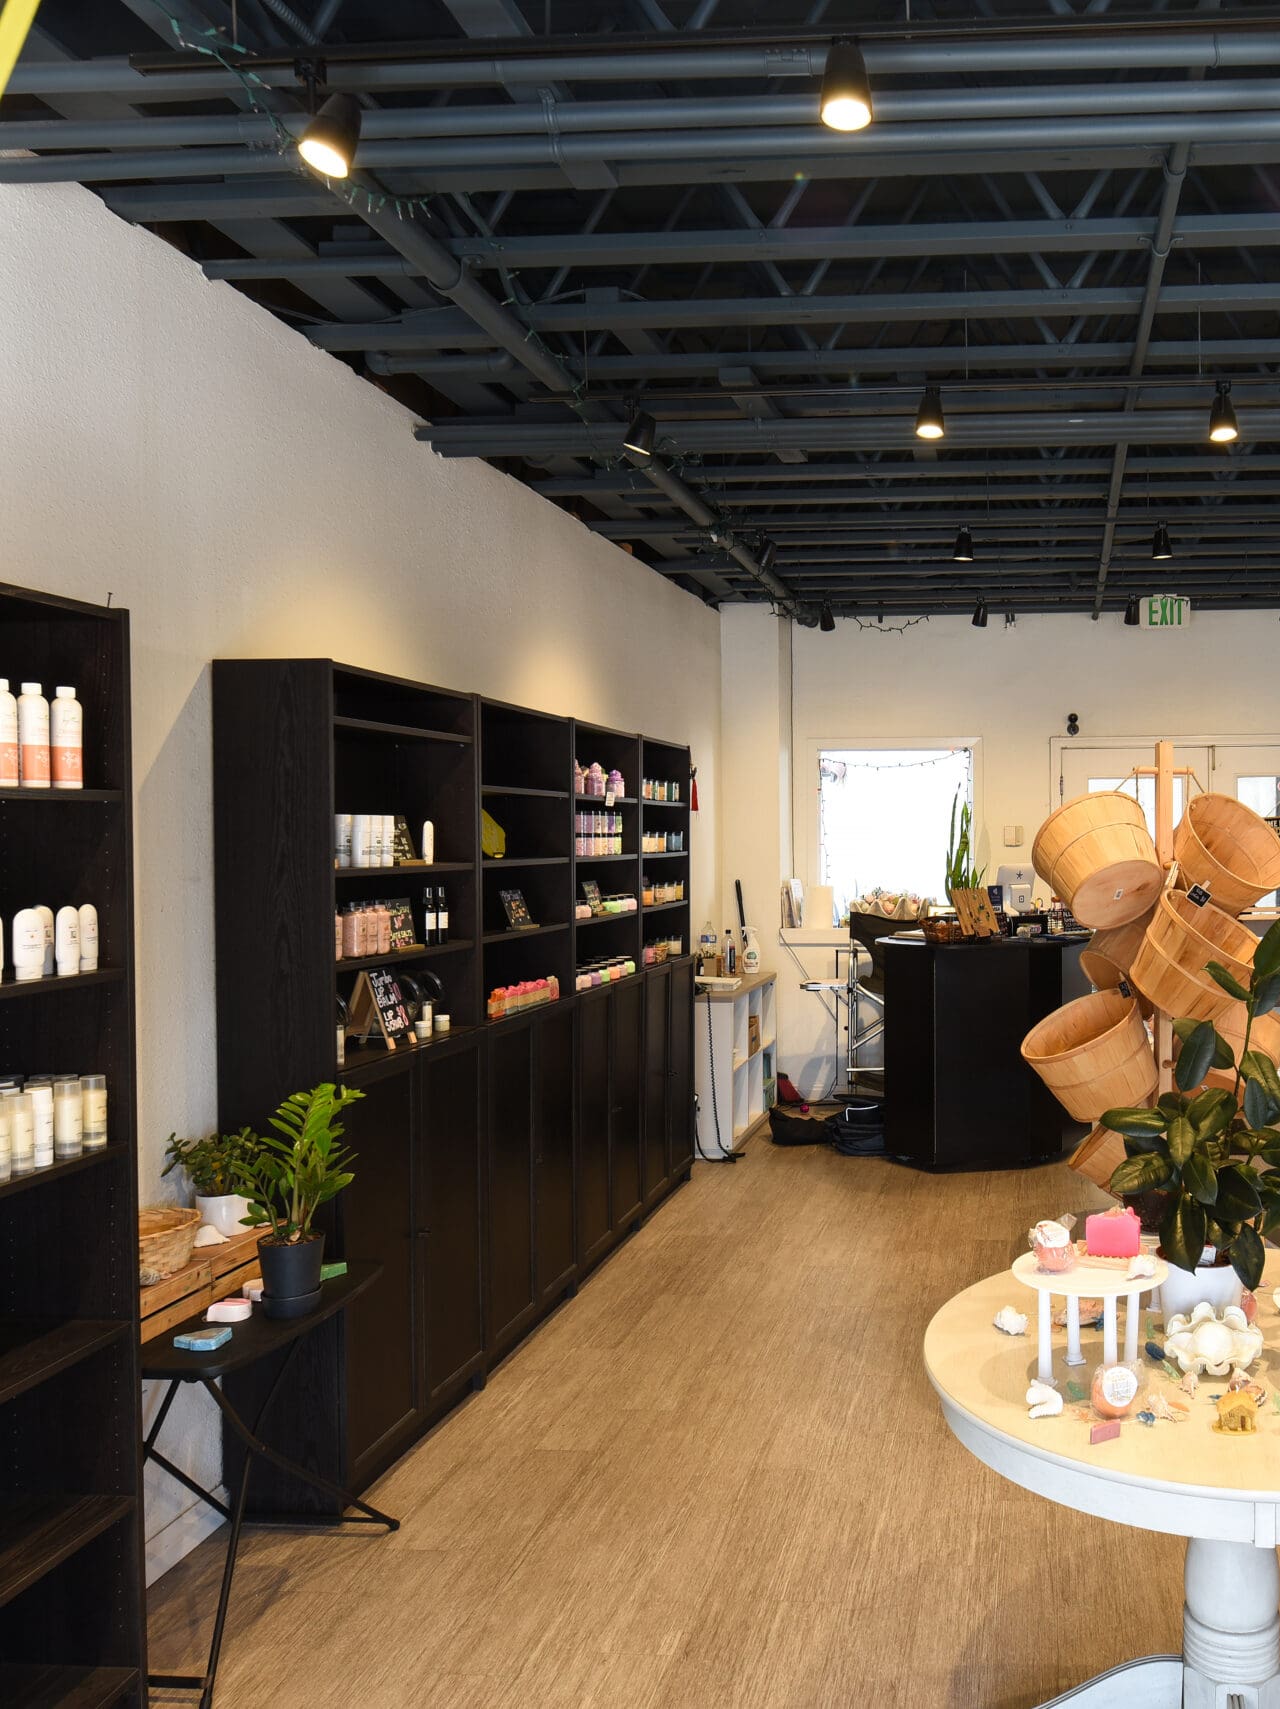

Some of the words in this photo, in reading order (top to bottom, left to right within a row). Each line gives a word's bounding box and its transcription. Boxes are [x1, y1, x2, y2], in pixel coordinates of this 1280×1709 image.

[1149, 598, 1184, 626] EXIT
[377, 993, 397, 1008] BALM
[383, 1010, 394, 1021] LIP
